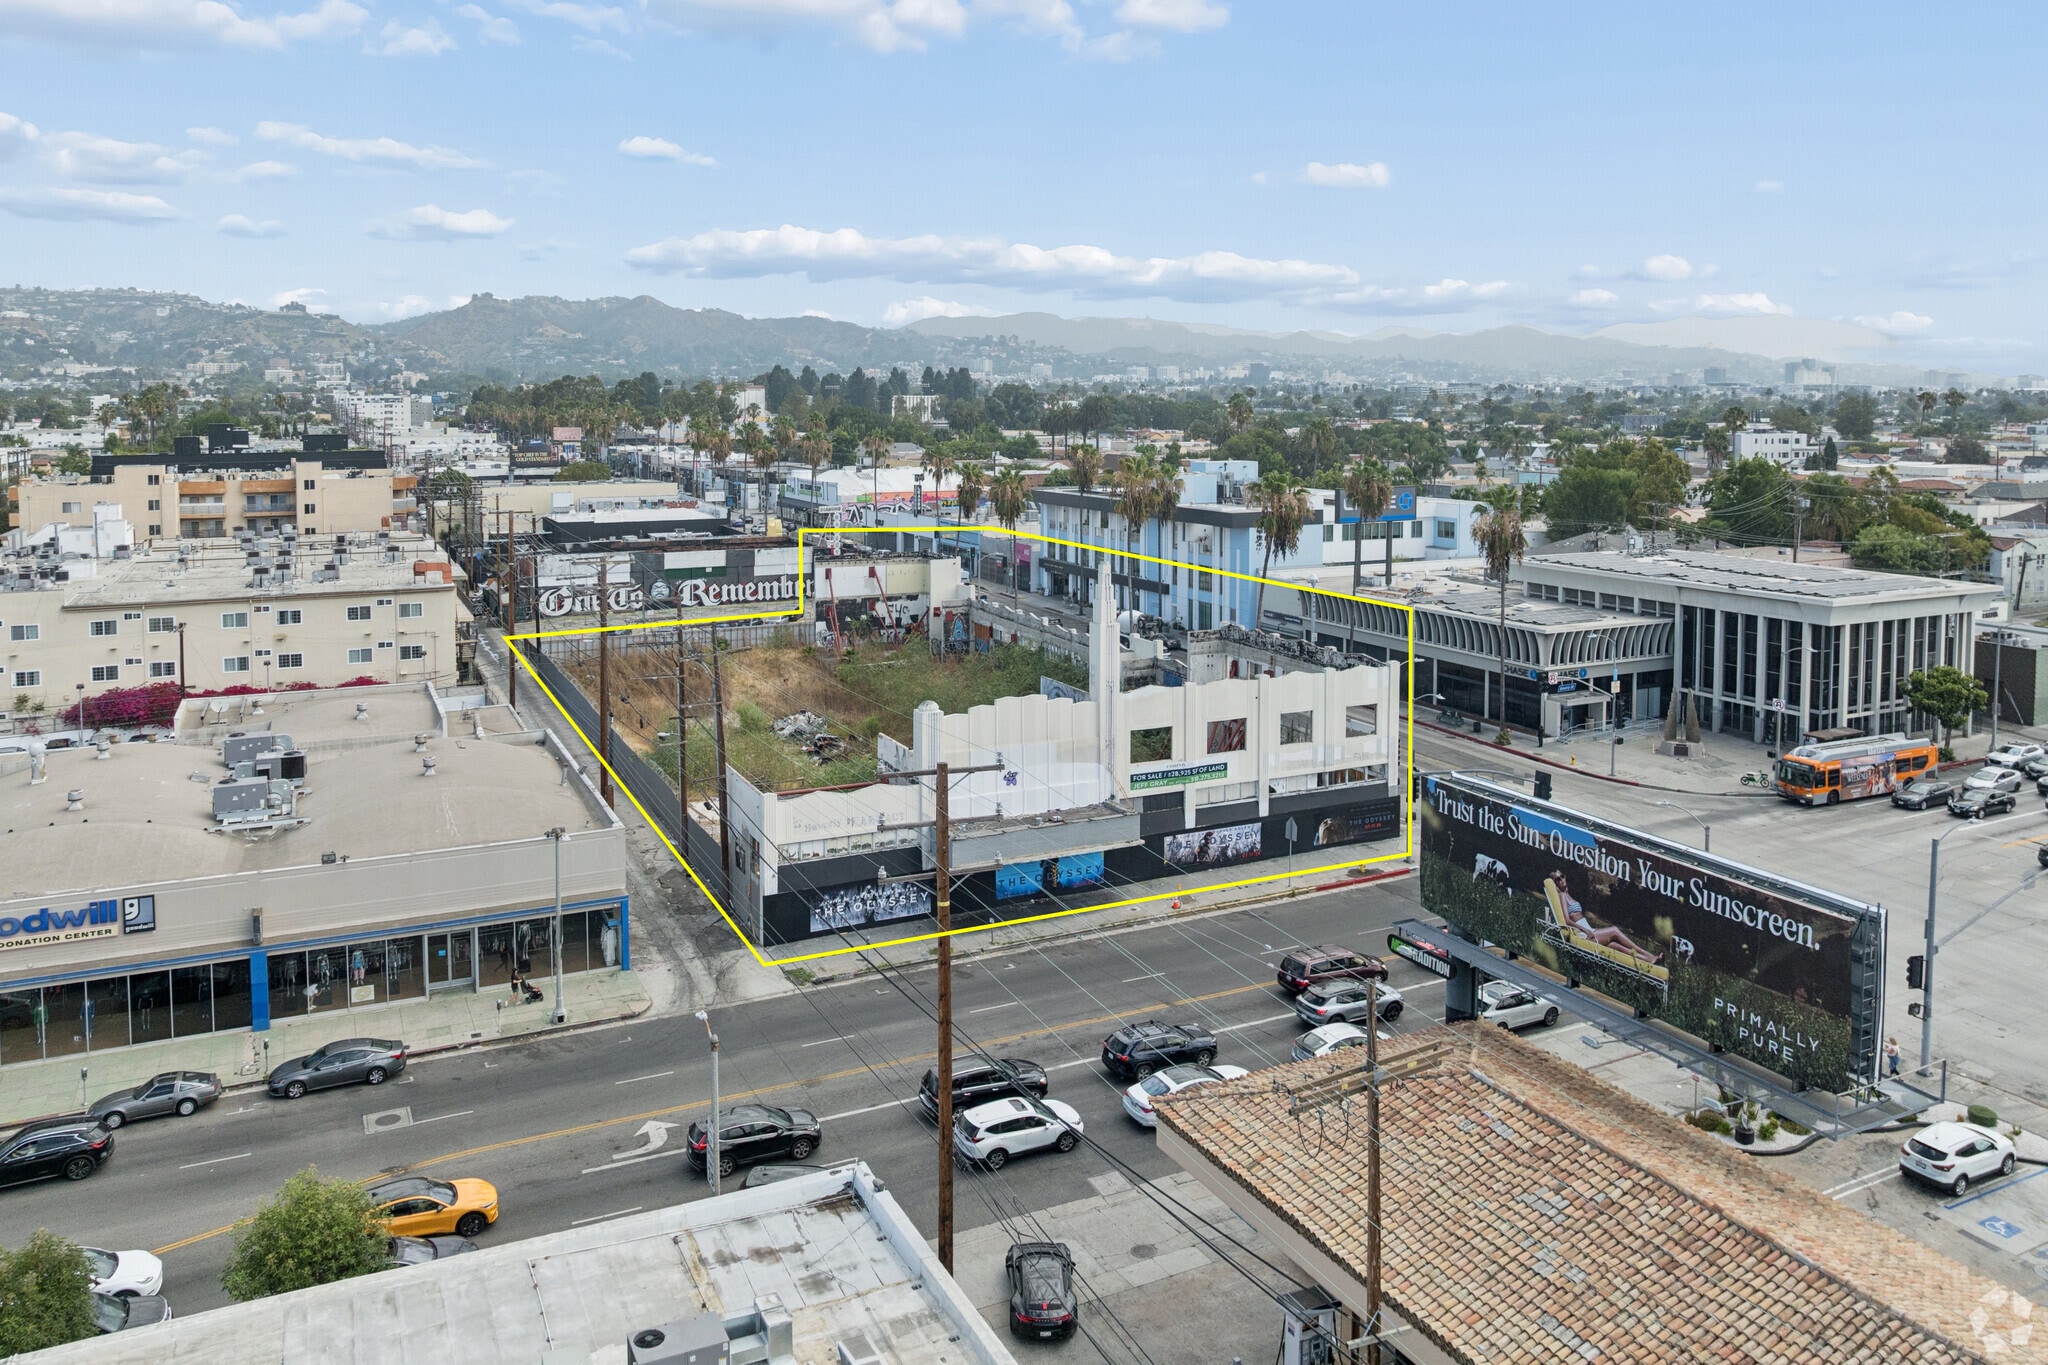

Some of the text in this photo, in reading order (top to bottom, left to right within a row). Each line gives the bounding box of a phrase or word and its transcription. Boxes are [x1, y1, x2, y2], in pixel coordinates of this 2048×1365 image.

[1557, 669, 1579, 678] HASE
[1365, 814, 1396, 824] ODYSSEY
[1436, 788, 1821, 951] Trust the Sun. Question Your Sunscreen.
[998, 876, 1026, 887] THE
[814, 904, 845, 919] THE
[853, 892, 929, 912] ODYSSEY
[125, 922, 154, 933] goodwill
[64, 928, 112, 940] CENTER
[1714, 997, 1819, 1052] PRIMALLY
[1739, 1027, 1794, 1062] PURE
